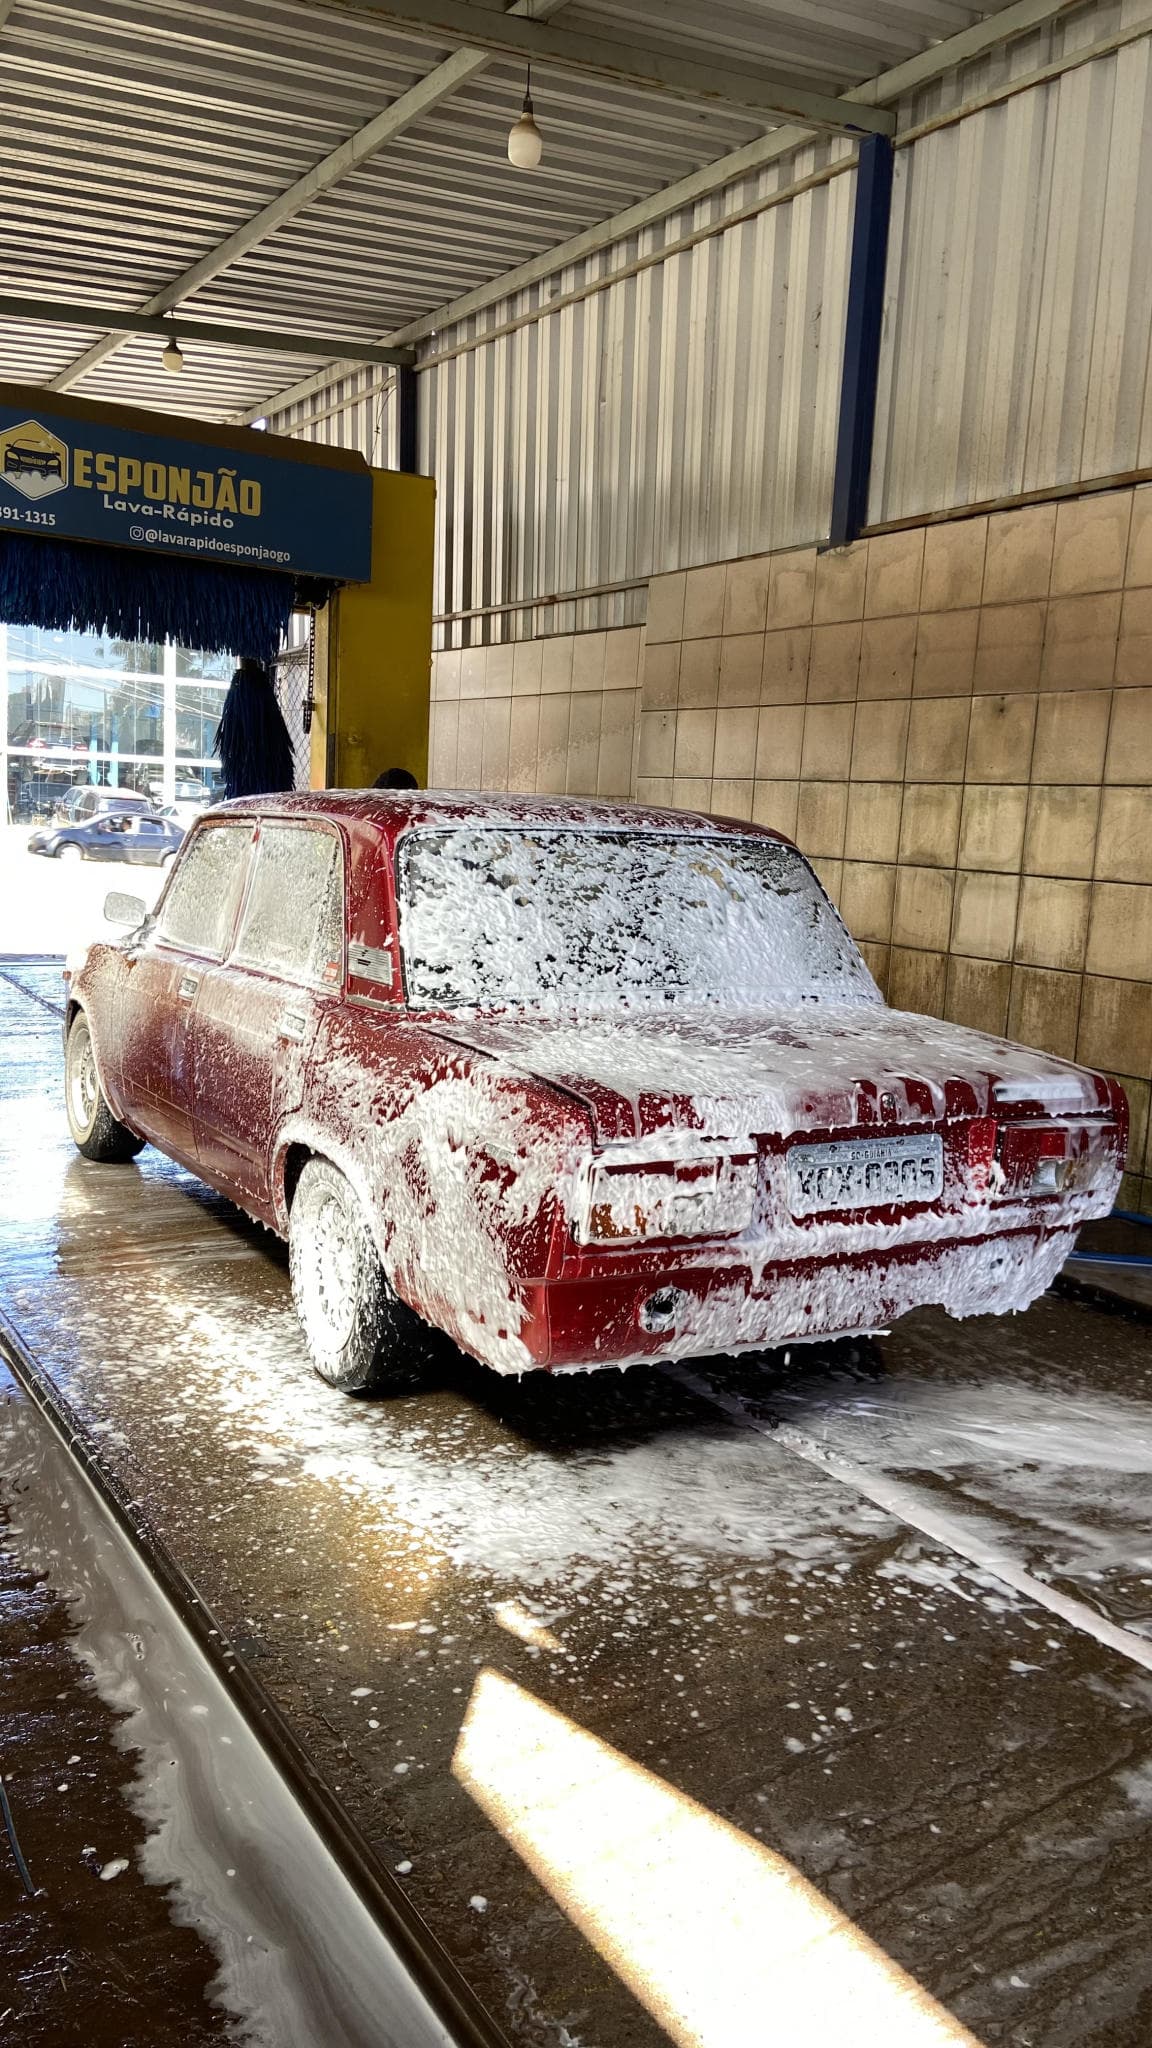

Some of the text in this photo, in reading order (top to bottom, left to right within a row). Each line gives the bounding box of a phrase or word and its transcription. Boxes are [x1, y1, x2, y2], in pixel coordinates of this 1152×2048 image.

[73, 448, 261, 517] ESPONJÃO
[0, 506, 56, 525] 91-1315
[103, 494, 234, 529] Lava-Rápido
[145, 529, 291, 563] @lavarapidoesponjaogo
